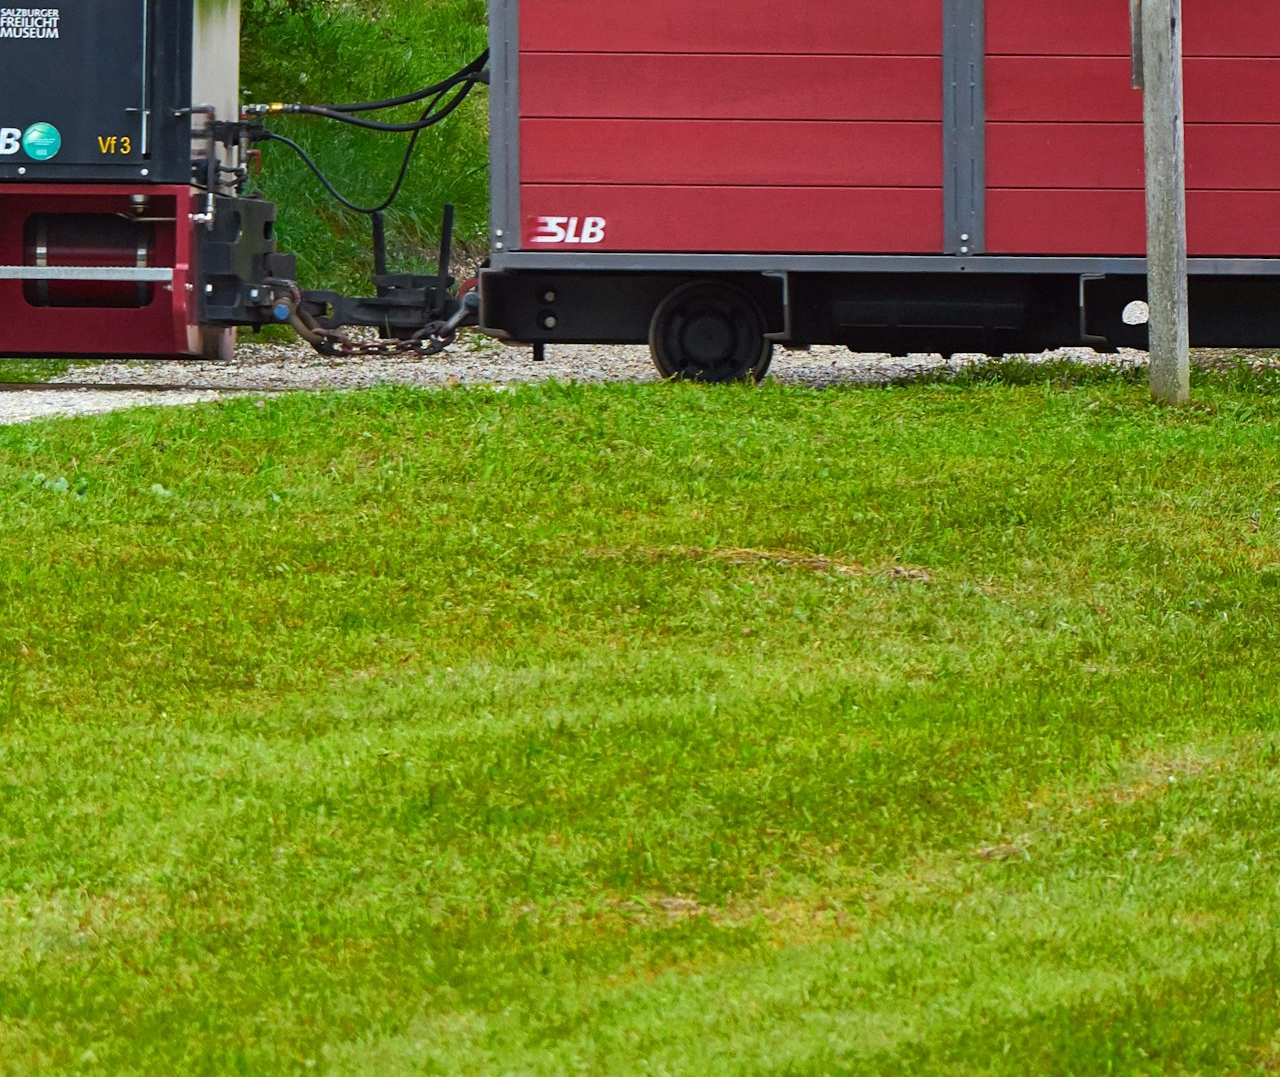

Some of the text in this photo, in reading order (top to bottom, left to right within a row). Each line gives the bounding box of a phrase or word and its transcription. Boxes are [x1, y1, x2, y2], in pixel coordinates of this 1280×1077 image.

[0, 8, 59, 17] SALZBURGER
[0, 17, 60, 28] FREILICHT
[0, 27, 59, 38] MUSEUM
[97, 136, 132, 154] Vf 3
[529, 216, 606, 243] SLB
